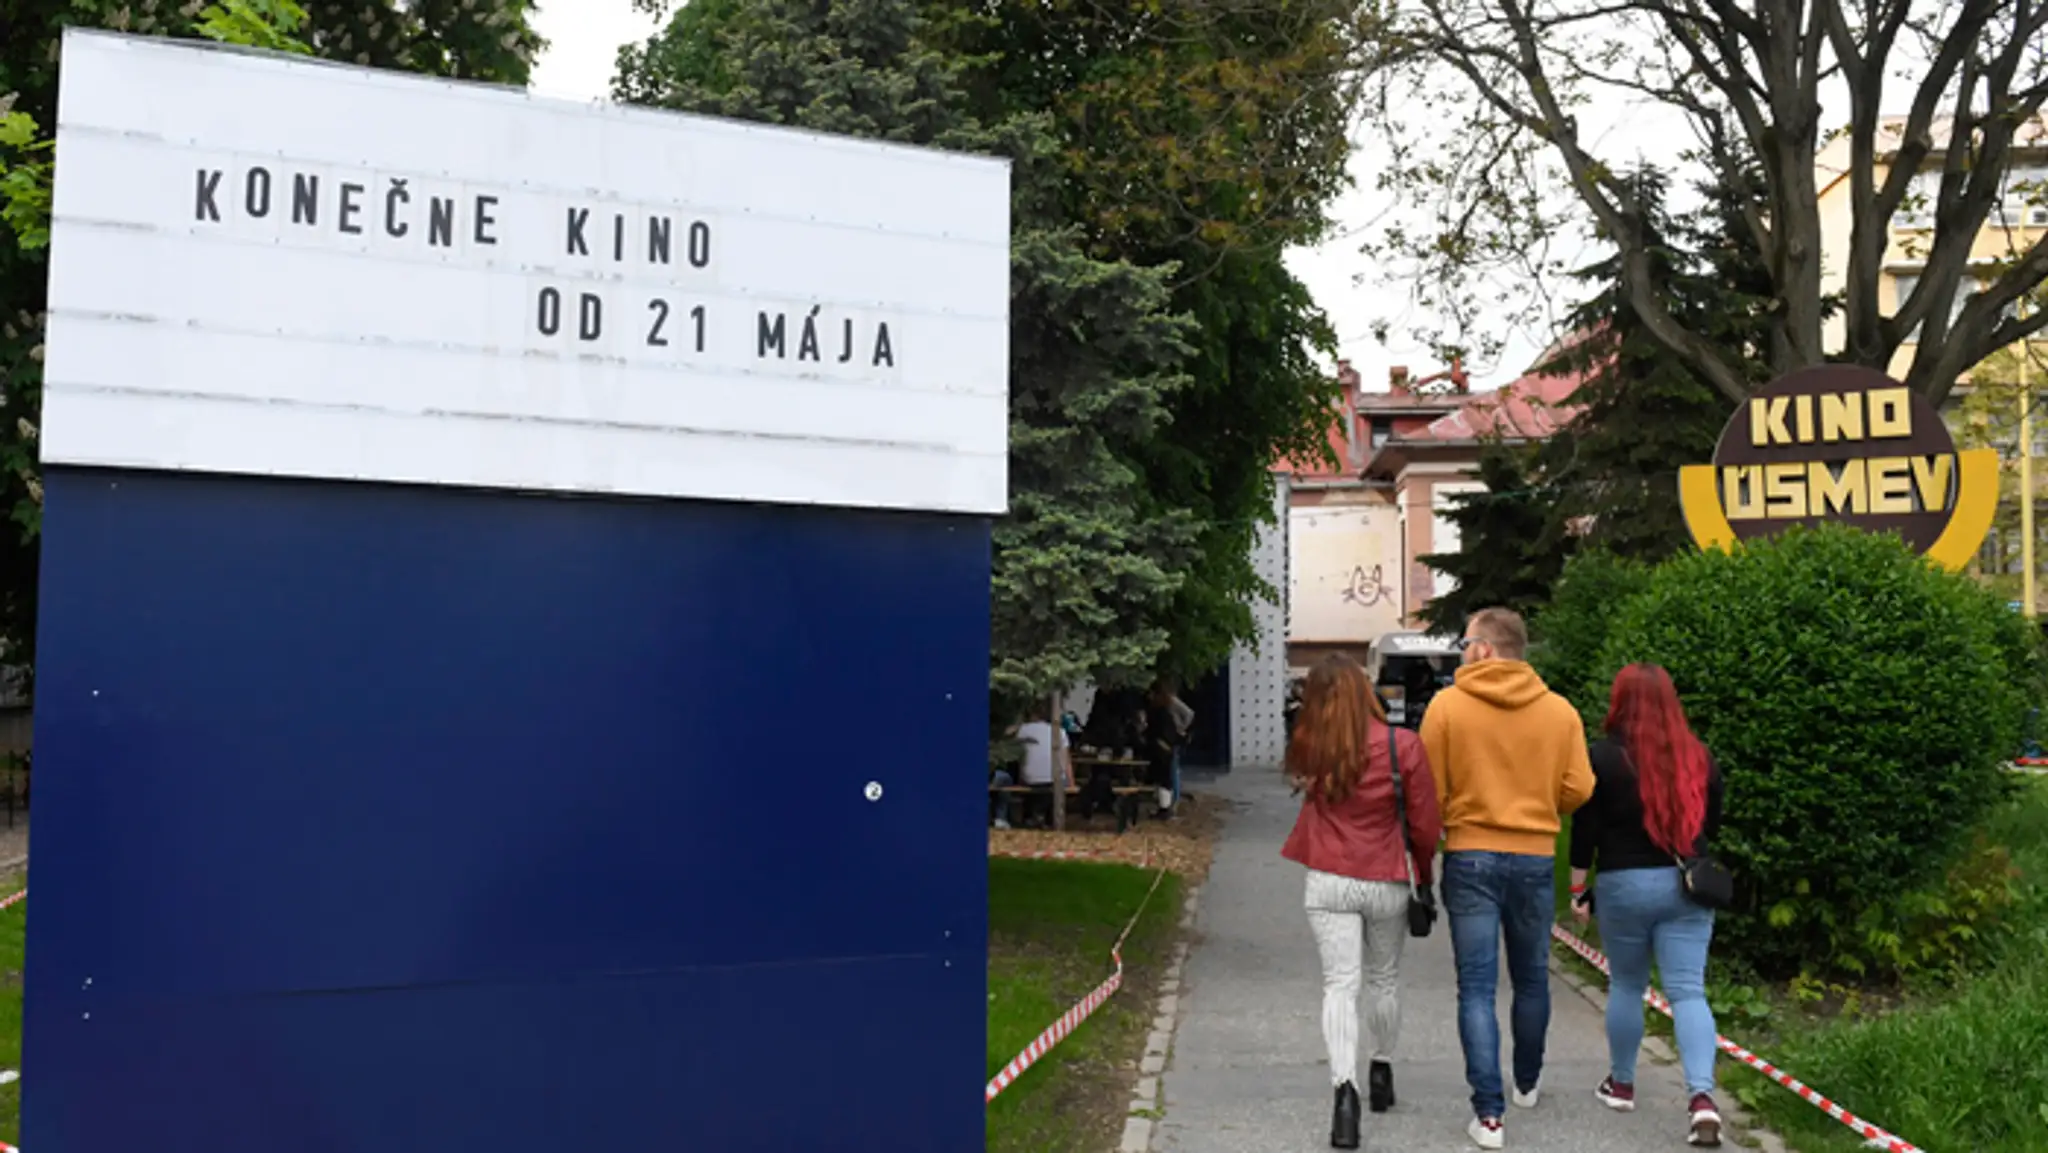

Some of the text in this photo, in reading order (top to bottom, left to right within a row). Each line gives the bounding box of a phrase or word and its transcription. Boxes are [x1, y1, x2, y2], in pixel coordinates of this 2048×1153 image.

[195, 166, 711, 268] KONEČNE KINO
[538, 286, 895, 368] OD 21 MÁJA
[1751, 387, 1912, 445] KINO
